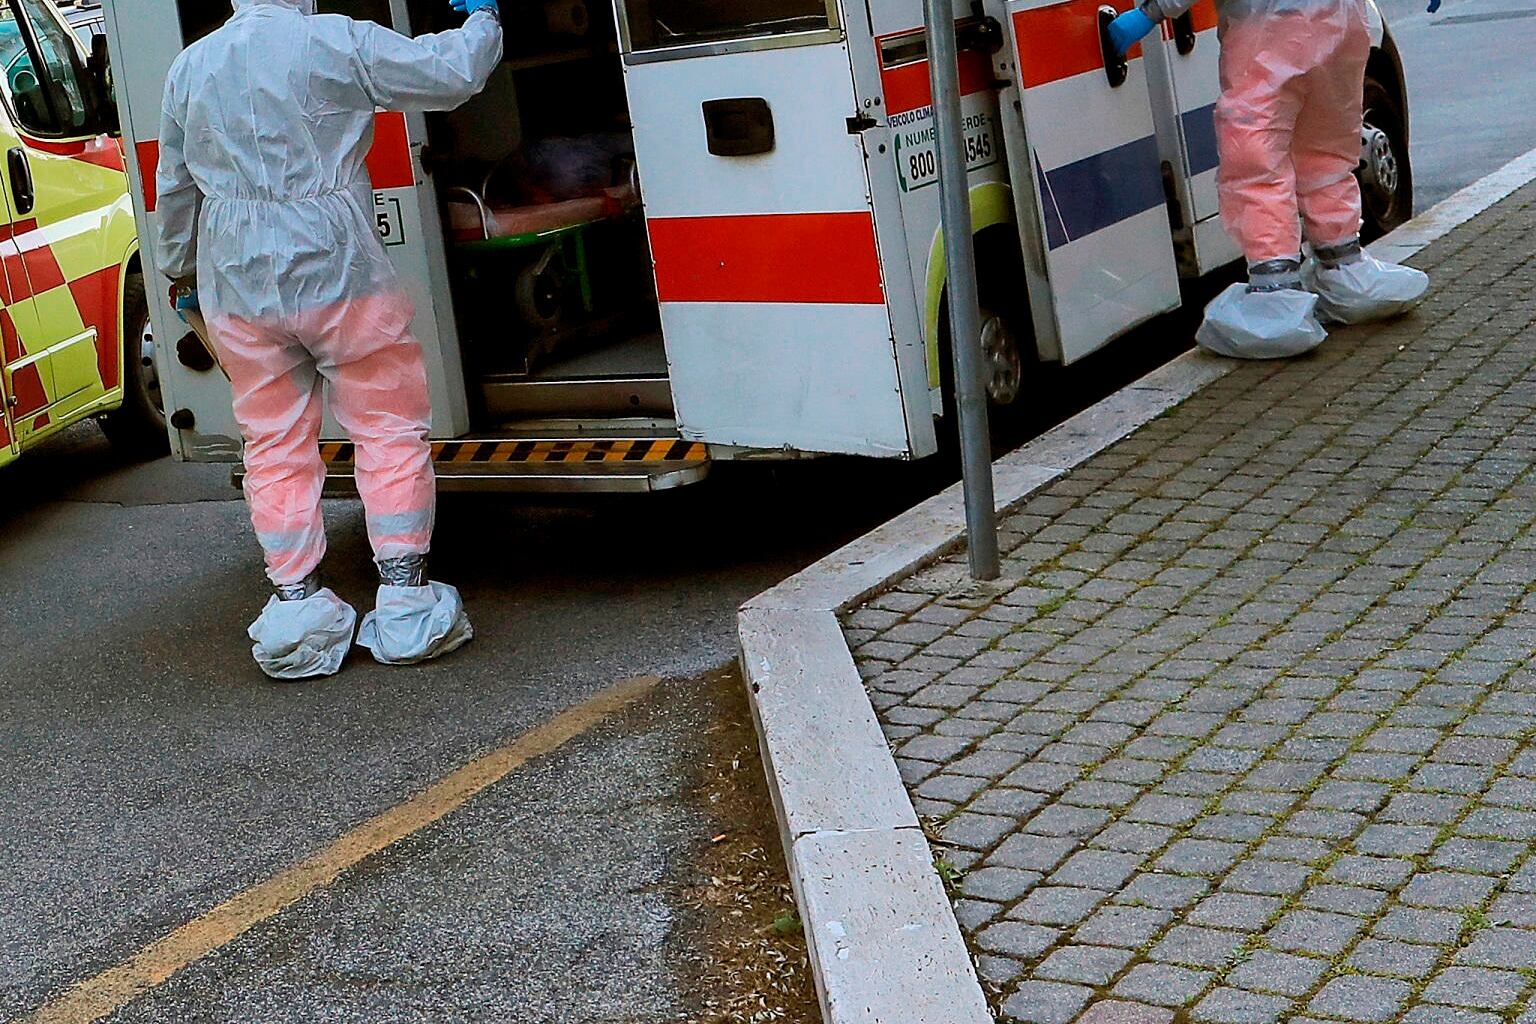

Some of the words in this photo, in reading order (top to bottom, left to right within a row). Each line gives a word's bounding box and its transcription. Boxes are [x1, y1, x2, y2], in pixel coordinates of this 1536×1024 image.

[886, 111, 915, 129] VEICOLO
[905, 127, 935, 147] NUME
[909, 150, 935, 180] 800
